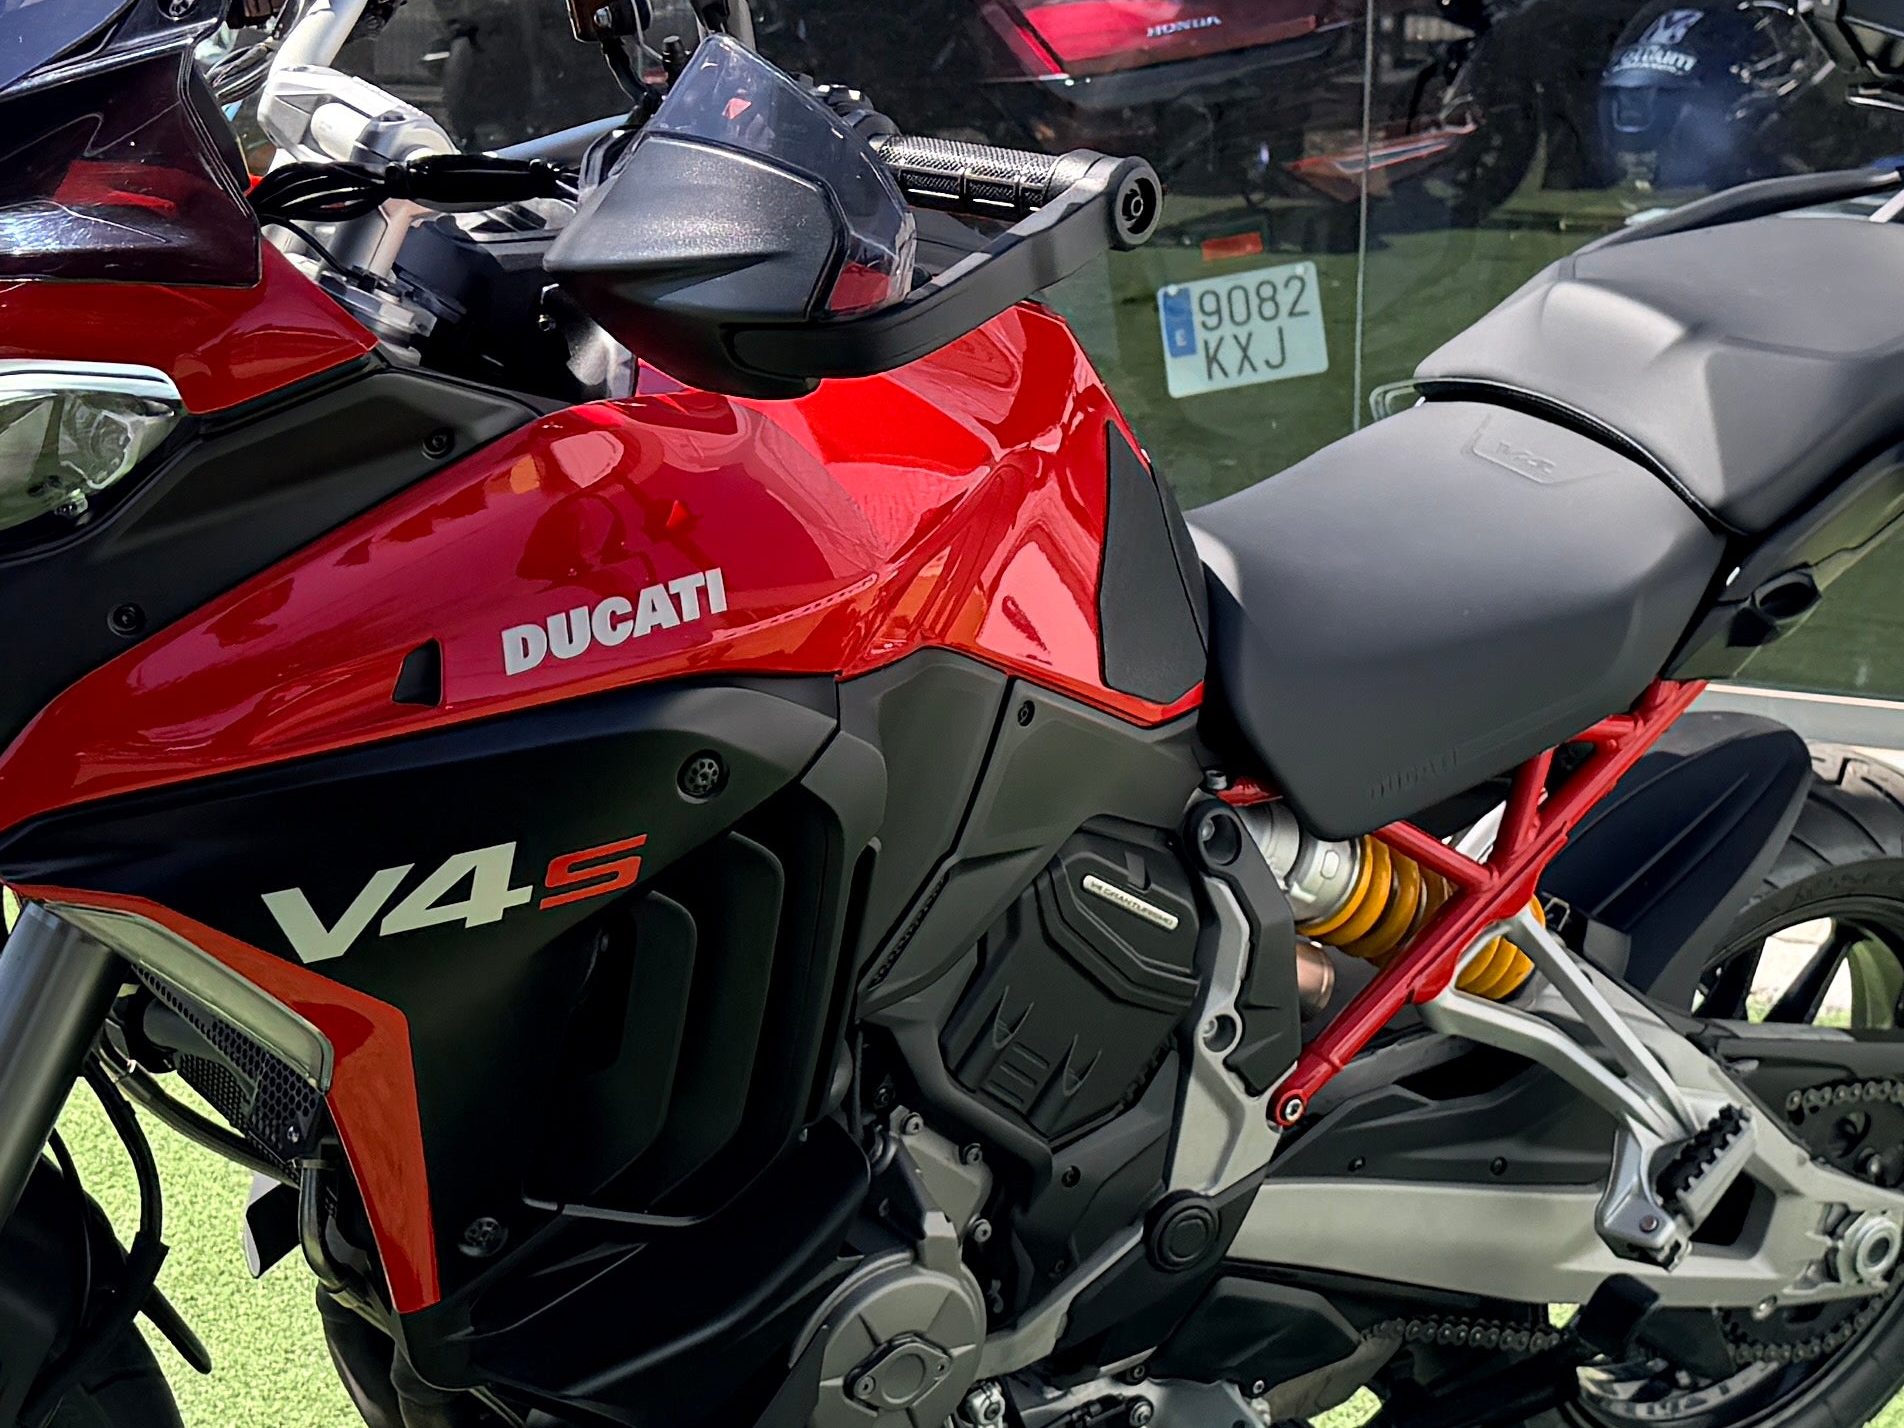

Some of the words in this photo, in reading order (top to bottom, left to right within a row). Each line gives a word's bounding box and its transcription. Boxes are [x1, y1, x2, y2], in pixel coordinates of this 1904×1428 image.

[1146, 14, 1223, 38] HONDA
[1198, 274, 1310, 332] 9082
[1203, 324, 1287, 381] KXJ
[501, 568, 729, 676] DUCATI
